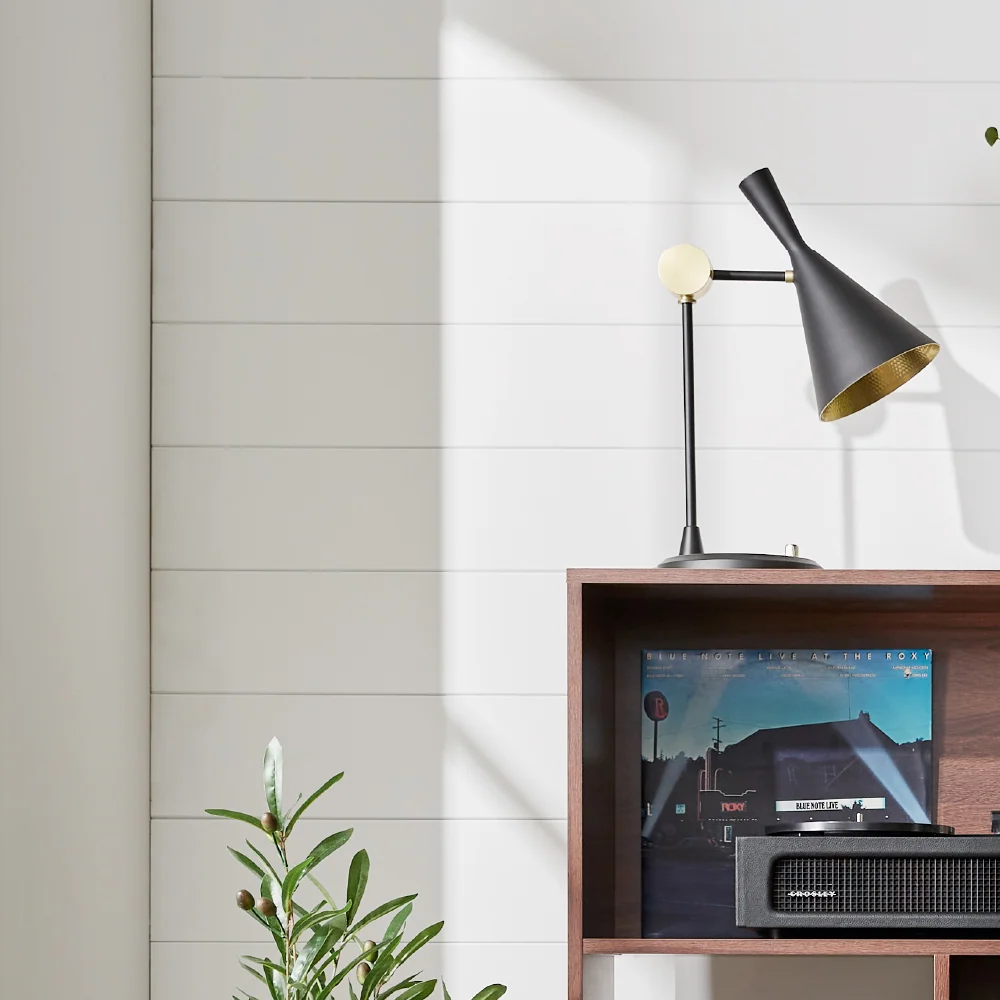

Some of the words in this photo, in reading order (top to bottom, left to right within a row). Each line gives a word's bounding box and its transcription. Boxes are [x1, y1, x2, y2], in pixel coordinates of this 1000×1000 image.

[646, 652, 687, 660] BLUE
[701, 652, 744, 660] NOTE
[758, 652, 797, 660] LIVE
[811, 652, 829, 660] AT
[843, 652, 872, 660] THE
[886, 652, 929, 660] ROXY
[721, 802, 745, 811] ROXY
[826, 801, 838, 809] LIVE
